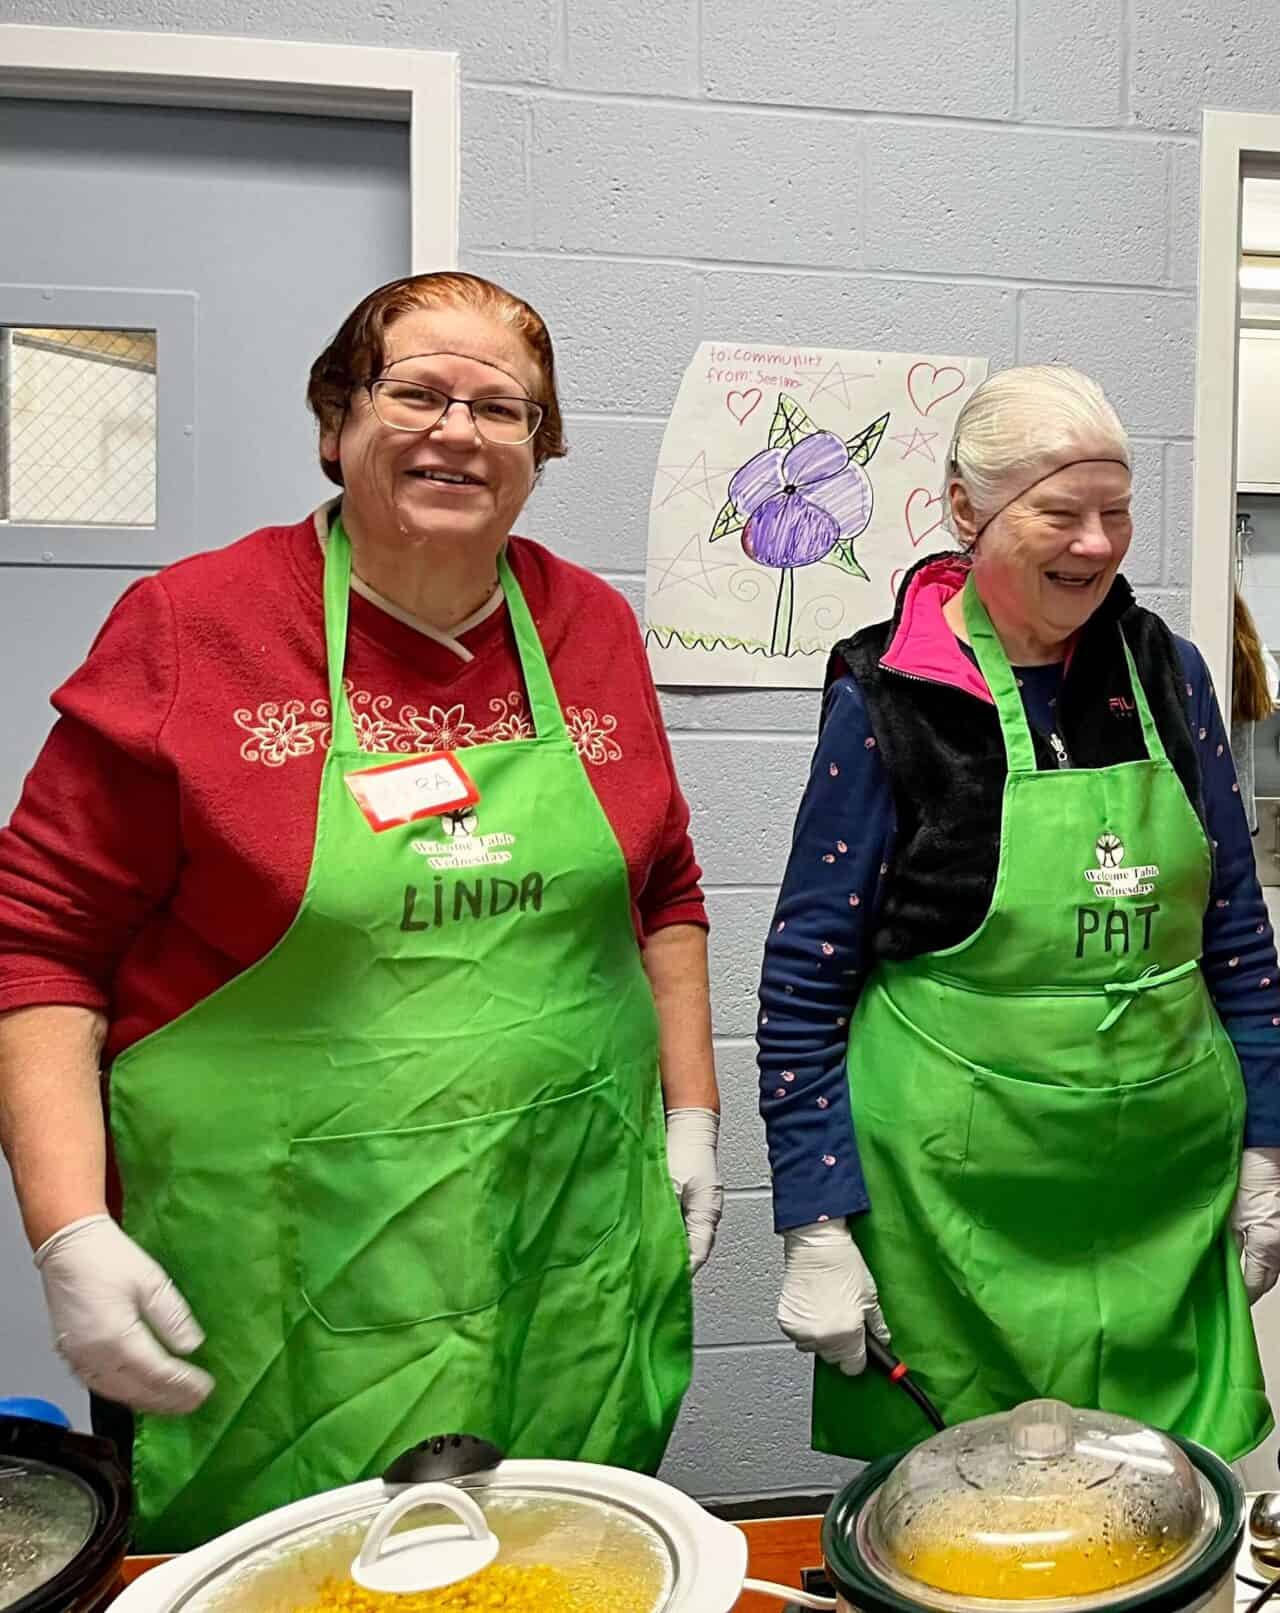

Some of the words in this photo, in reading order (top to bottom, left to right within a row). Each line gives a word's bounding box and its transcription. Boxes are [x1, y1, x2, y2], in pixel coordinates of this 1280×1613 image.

[1109, 696, 1136, 711] FIL
[1085, 871, 1129, 881] Welcome
[1075, 903, 1161, 959] PAT
